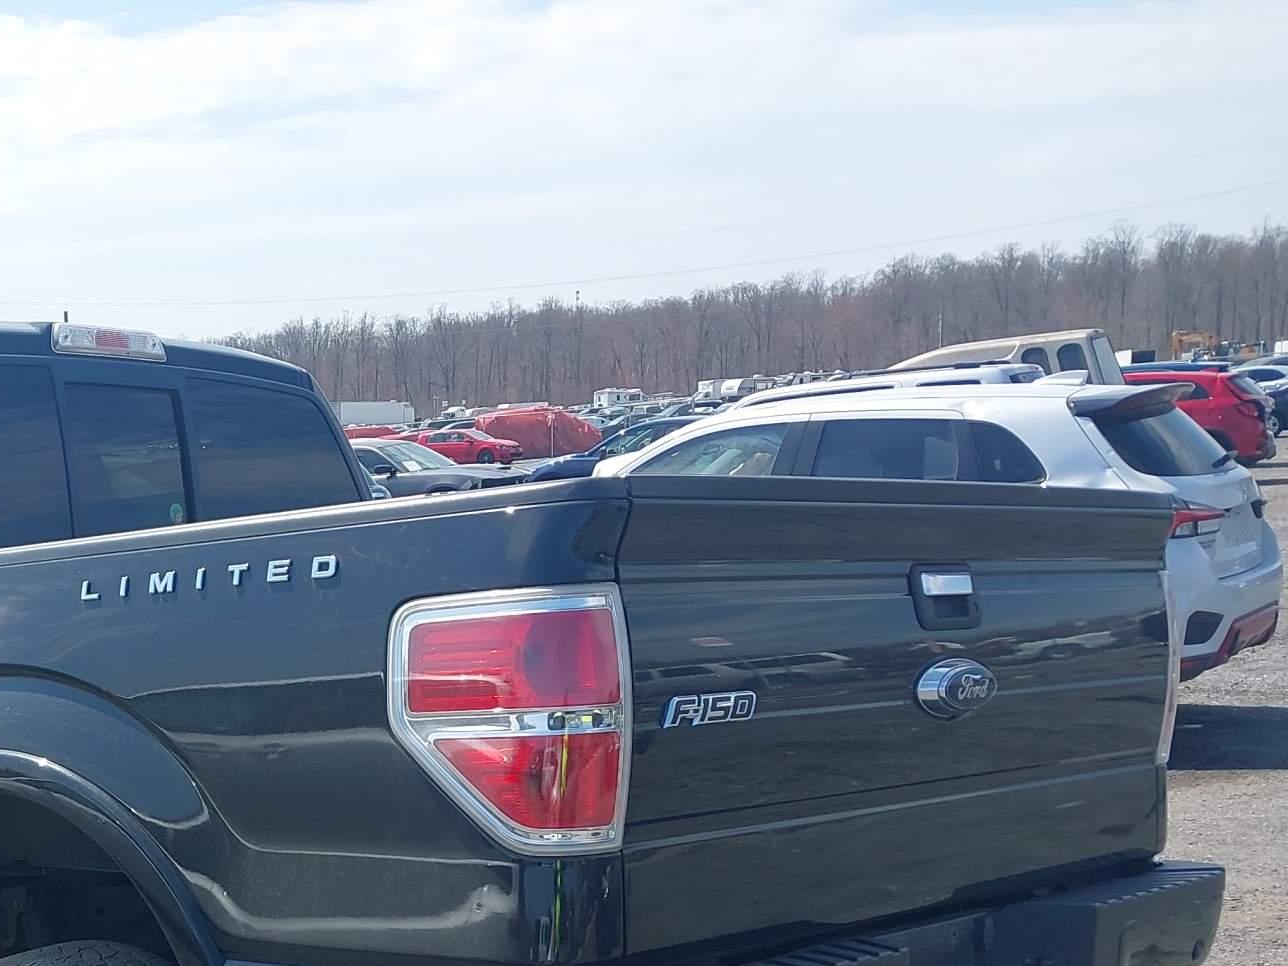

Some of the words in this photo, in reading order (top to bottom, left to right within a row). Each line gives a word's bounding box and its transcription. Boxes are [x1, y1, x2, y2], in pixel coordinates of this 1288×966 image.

[80, 554, 338, 601] LIMITED
[958, 673, 990, 700] Ford
[663, 690, 756, 728] F-150
